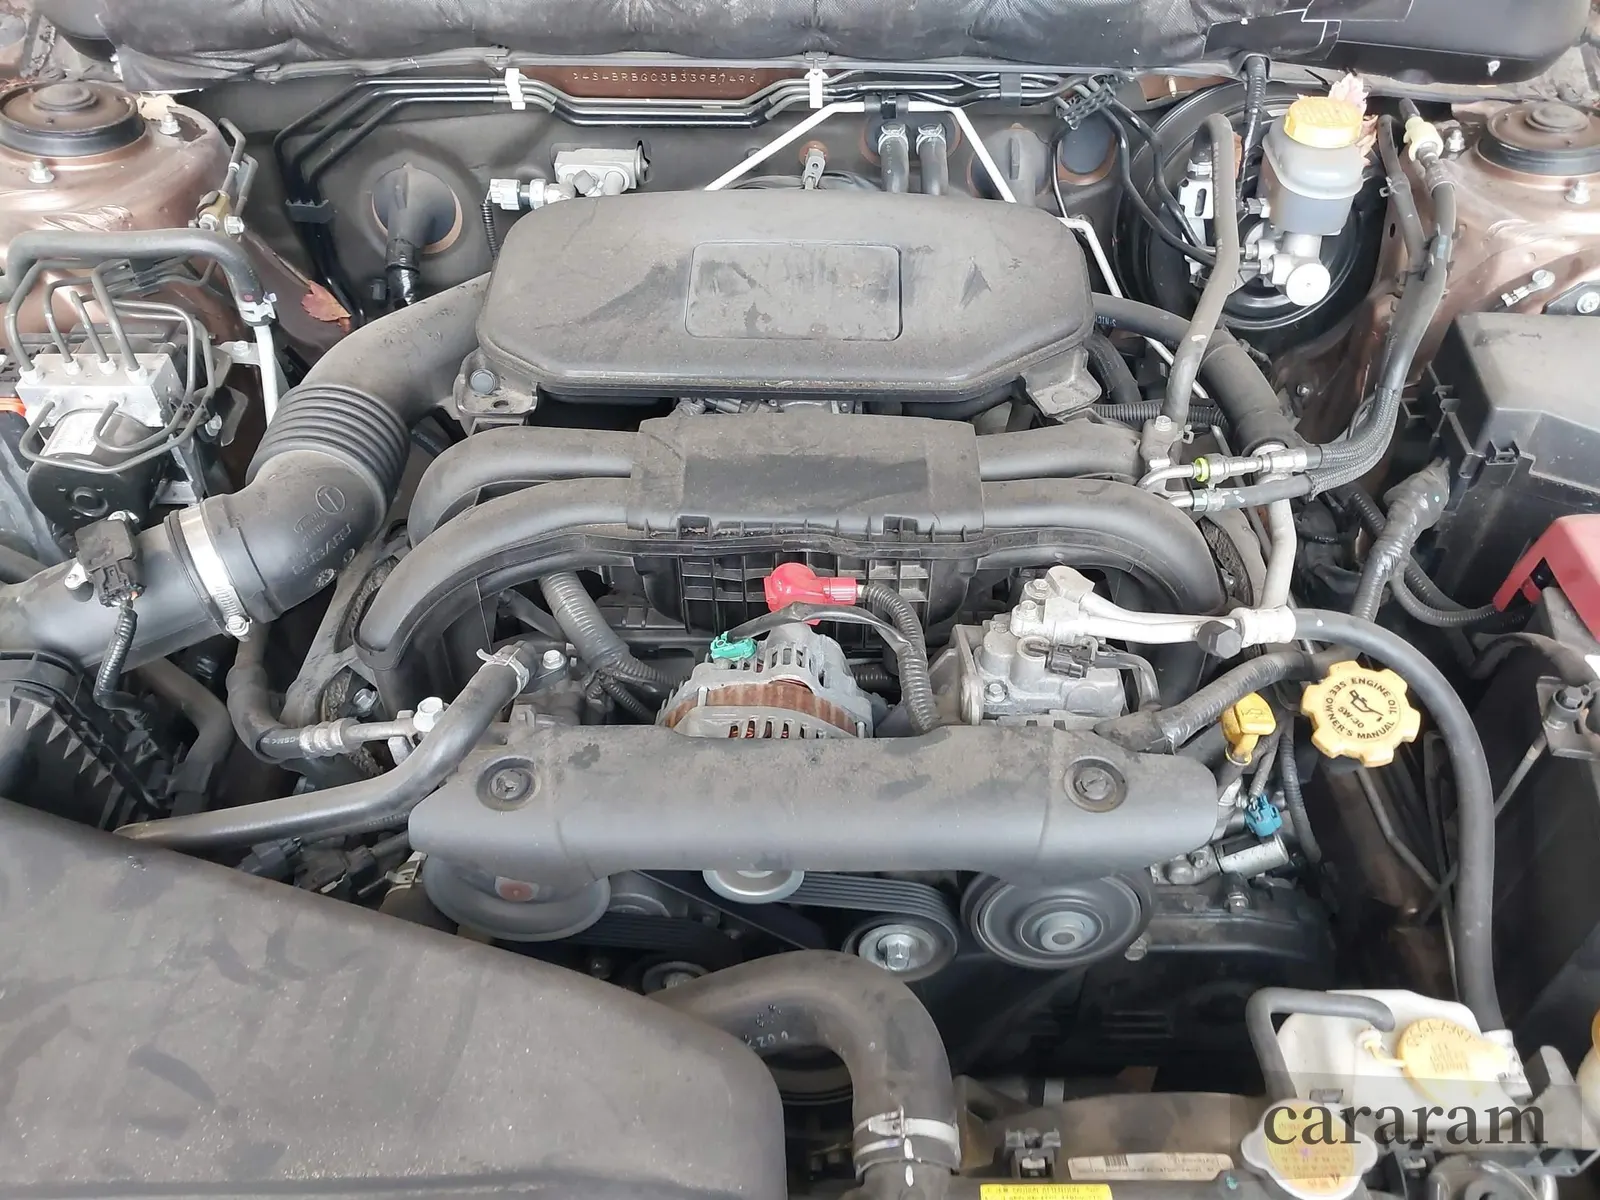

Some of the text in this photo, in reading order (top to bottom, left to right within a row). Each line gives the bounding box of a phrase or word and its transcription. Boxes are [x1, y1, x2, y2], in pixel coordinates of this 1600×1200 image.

[1325, 681, 1395, 739] SEE OWNER'S MANUAL
[1351, 677, 1397, 715] ENGINE OIL
[1338, 706, 1365, 728] 5W-30
